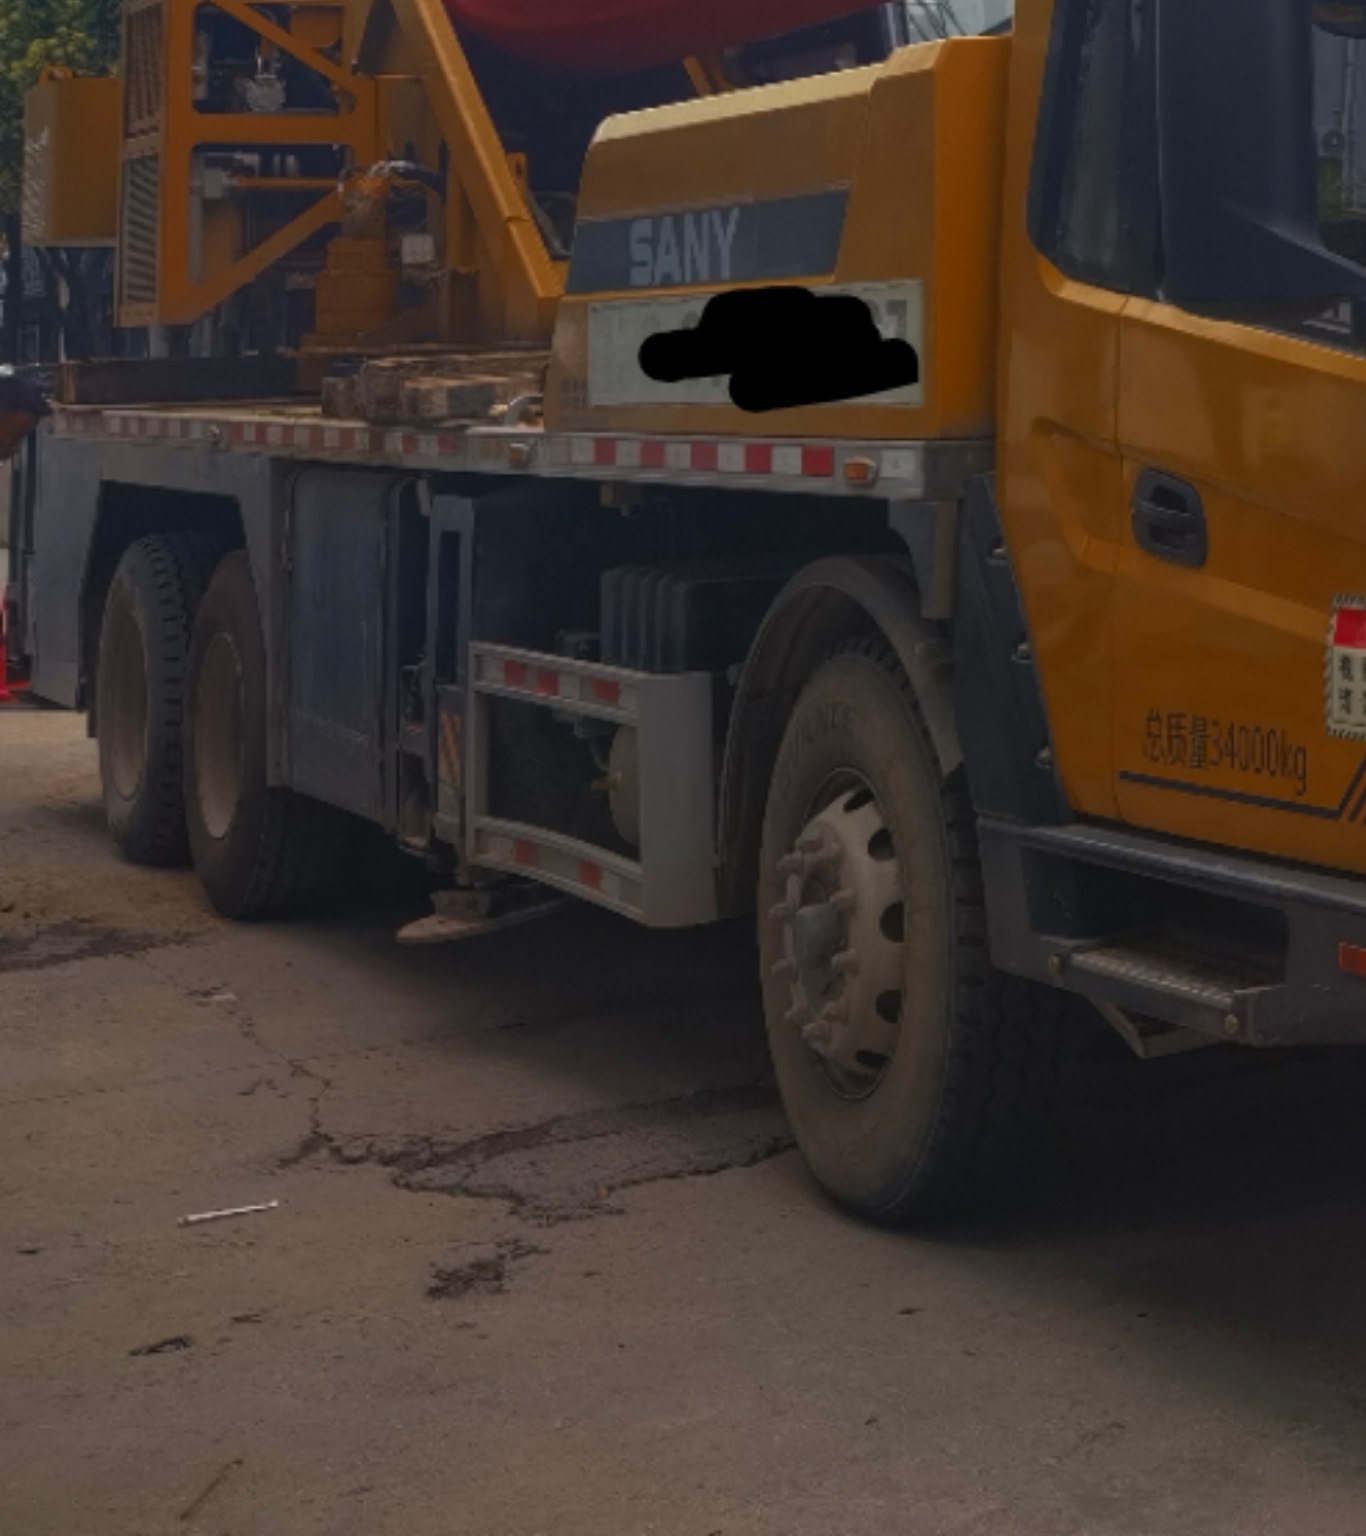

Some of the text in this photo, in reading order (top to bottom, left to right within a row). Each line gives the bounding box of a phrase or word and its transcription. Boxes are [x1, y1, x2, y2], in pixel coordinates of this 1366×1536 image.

[629, 207, 741, 287] SANY
[1143, 707, 1308, 796] 总质量34000kg
